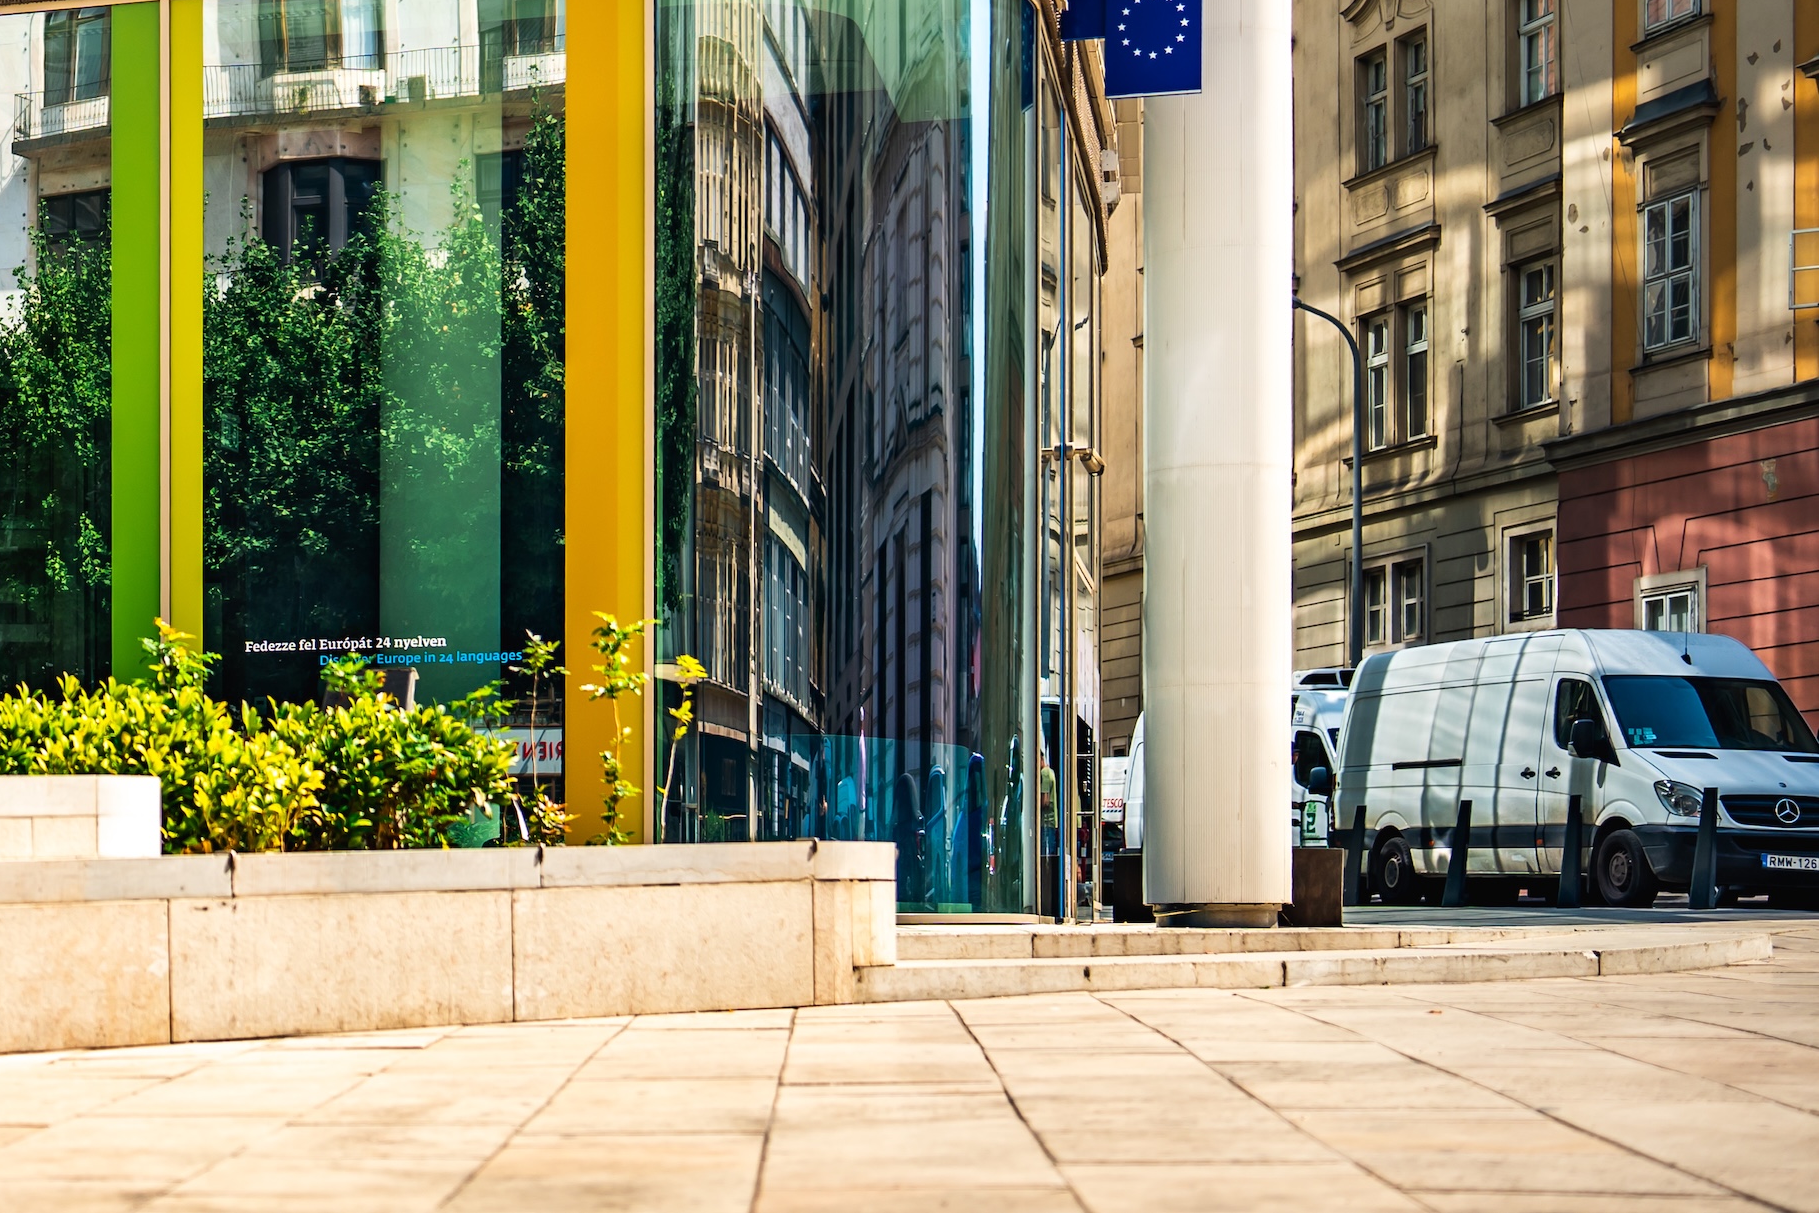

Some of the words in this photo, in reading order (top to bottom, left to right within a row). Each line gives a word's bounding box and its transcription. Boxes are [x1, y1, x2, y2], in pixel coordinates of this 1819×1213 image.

[244, 640, 296, 652] Fedezze
[298, 639, 317, 651] fel
[319, 636, 373, 651] Európát
[375, 637, 391, 648] 24
[394, 636, 447, 650] nyelven
[376, 652, 421, 665] Europe
[424, 651, 436, 663] in
[439, 654, 453, 664] 24
[456, 651, 523, 664] languages
[1102, 798, 1123, 808] TESCO
[1769, 856, 1817, 869] RMW-126
